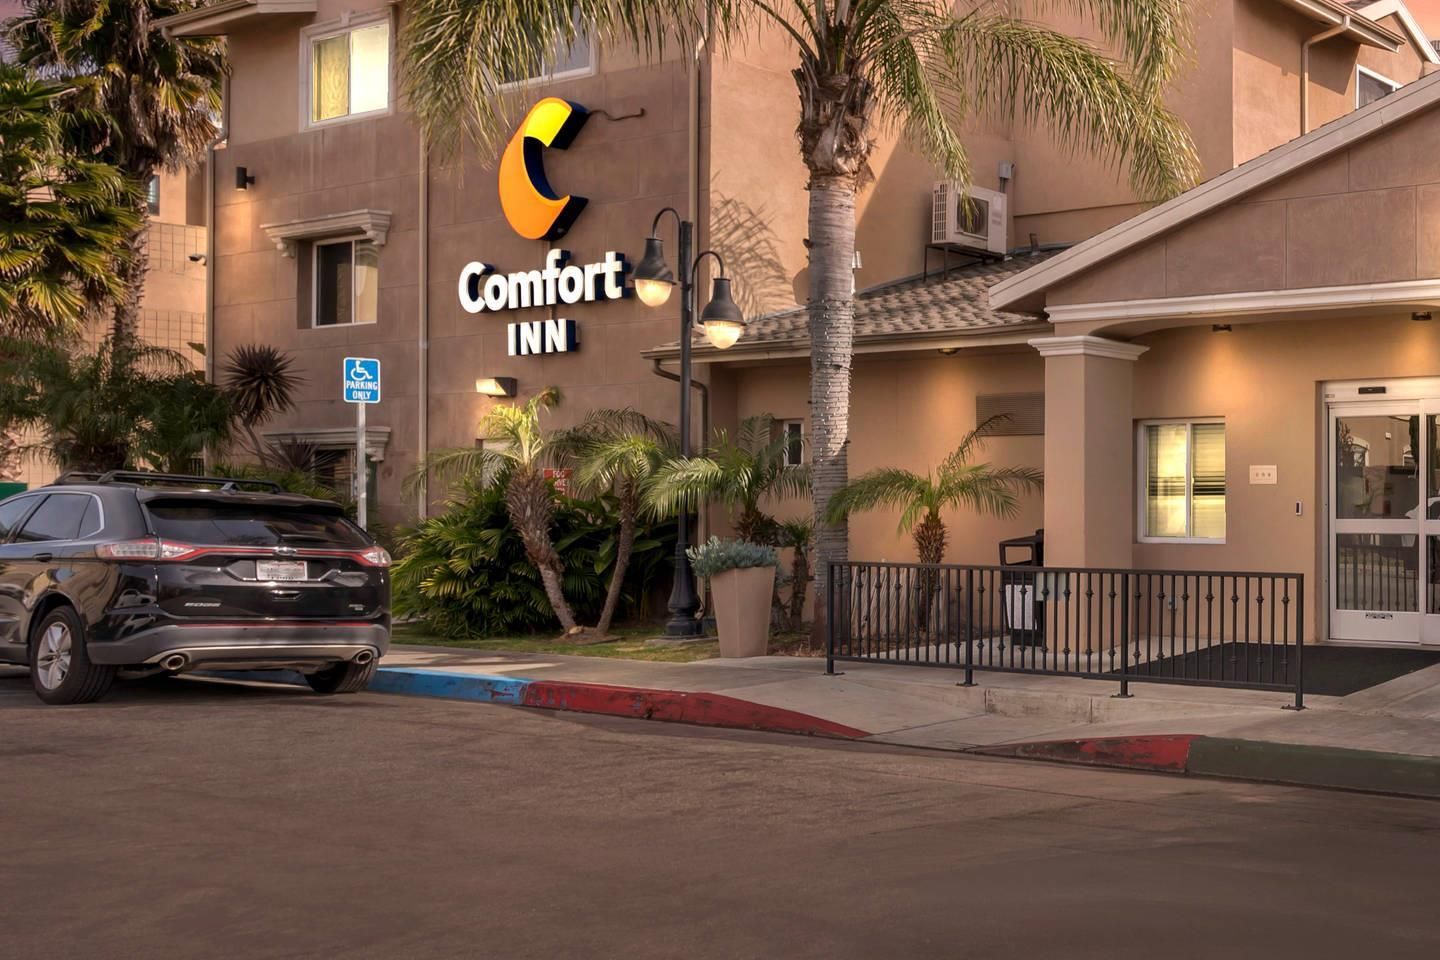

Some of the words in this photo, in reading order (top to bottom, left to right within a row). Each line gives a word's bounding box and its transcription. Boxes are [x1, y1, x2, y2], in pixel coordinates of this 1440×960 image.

[458, 248, 623, 314] Comfort
[507, 318, 568, 356] INN
[346, 380, 378, 390] PARKING
[352, 390, 372, 400] ONLY
